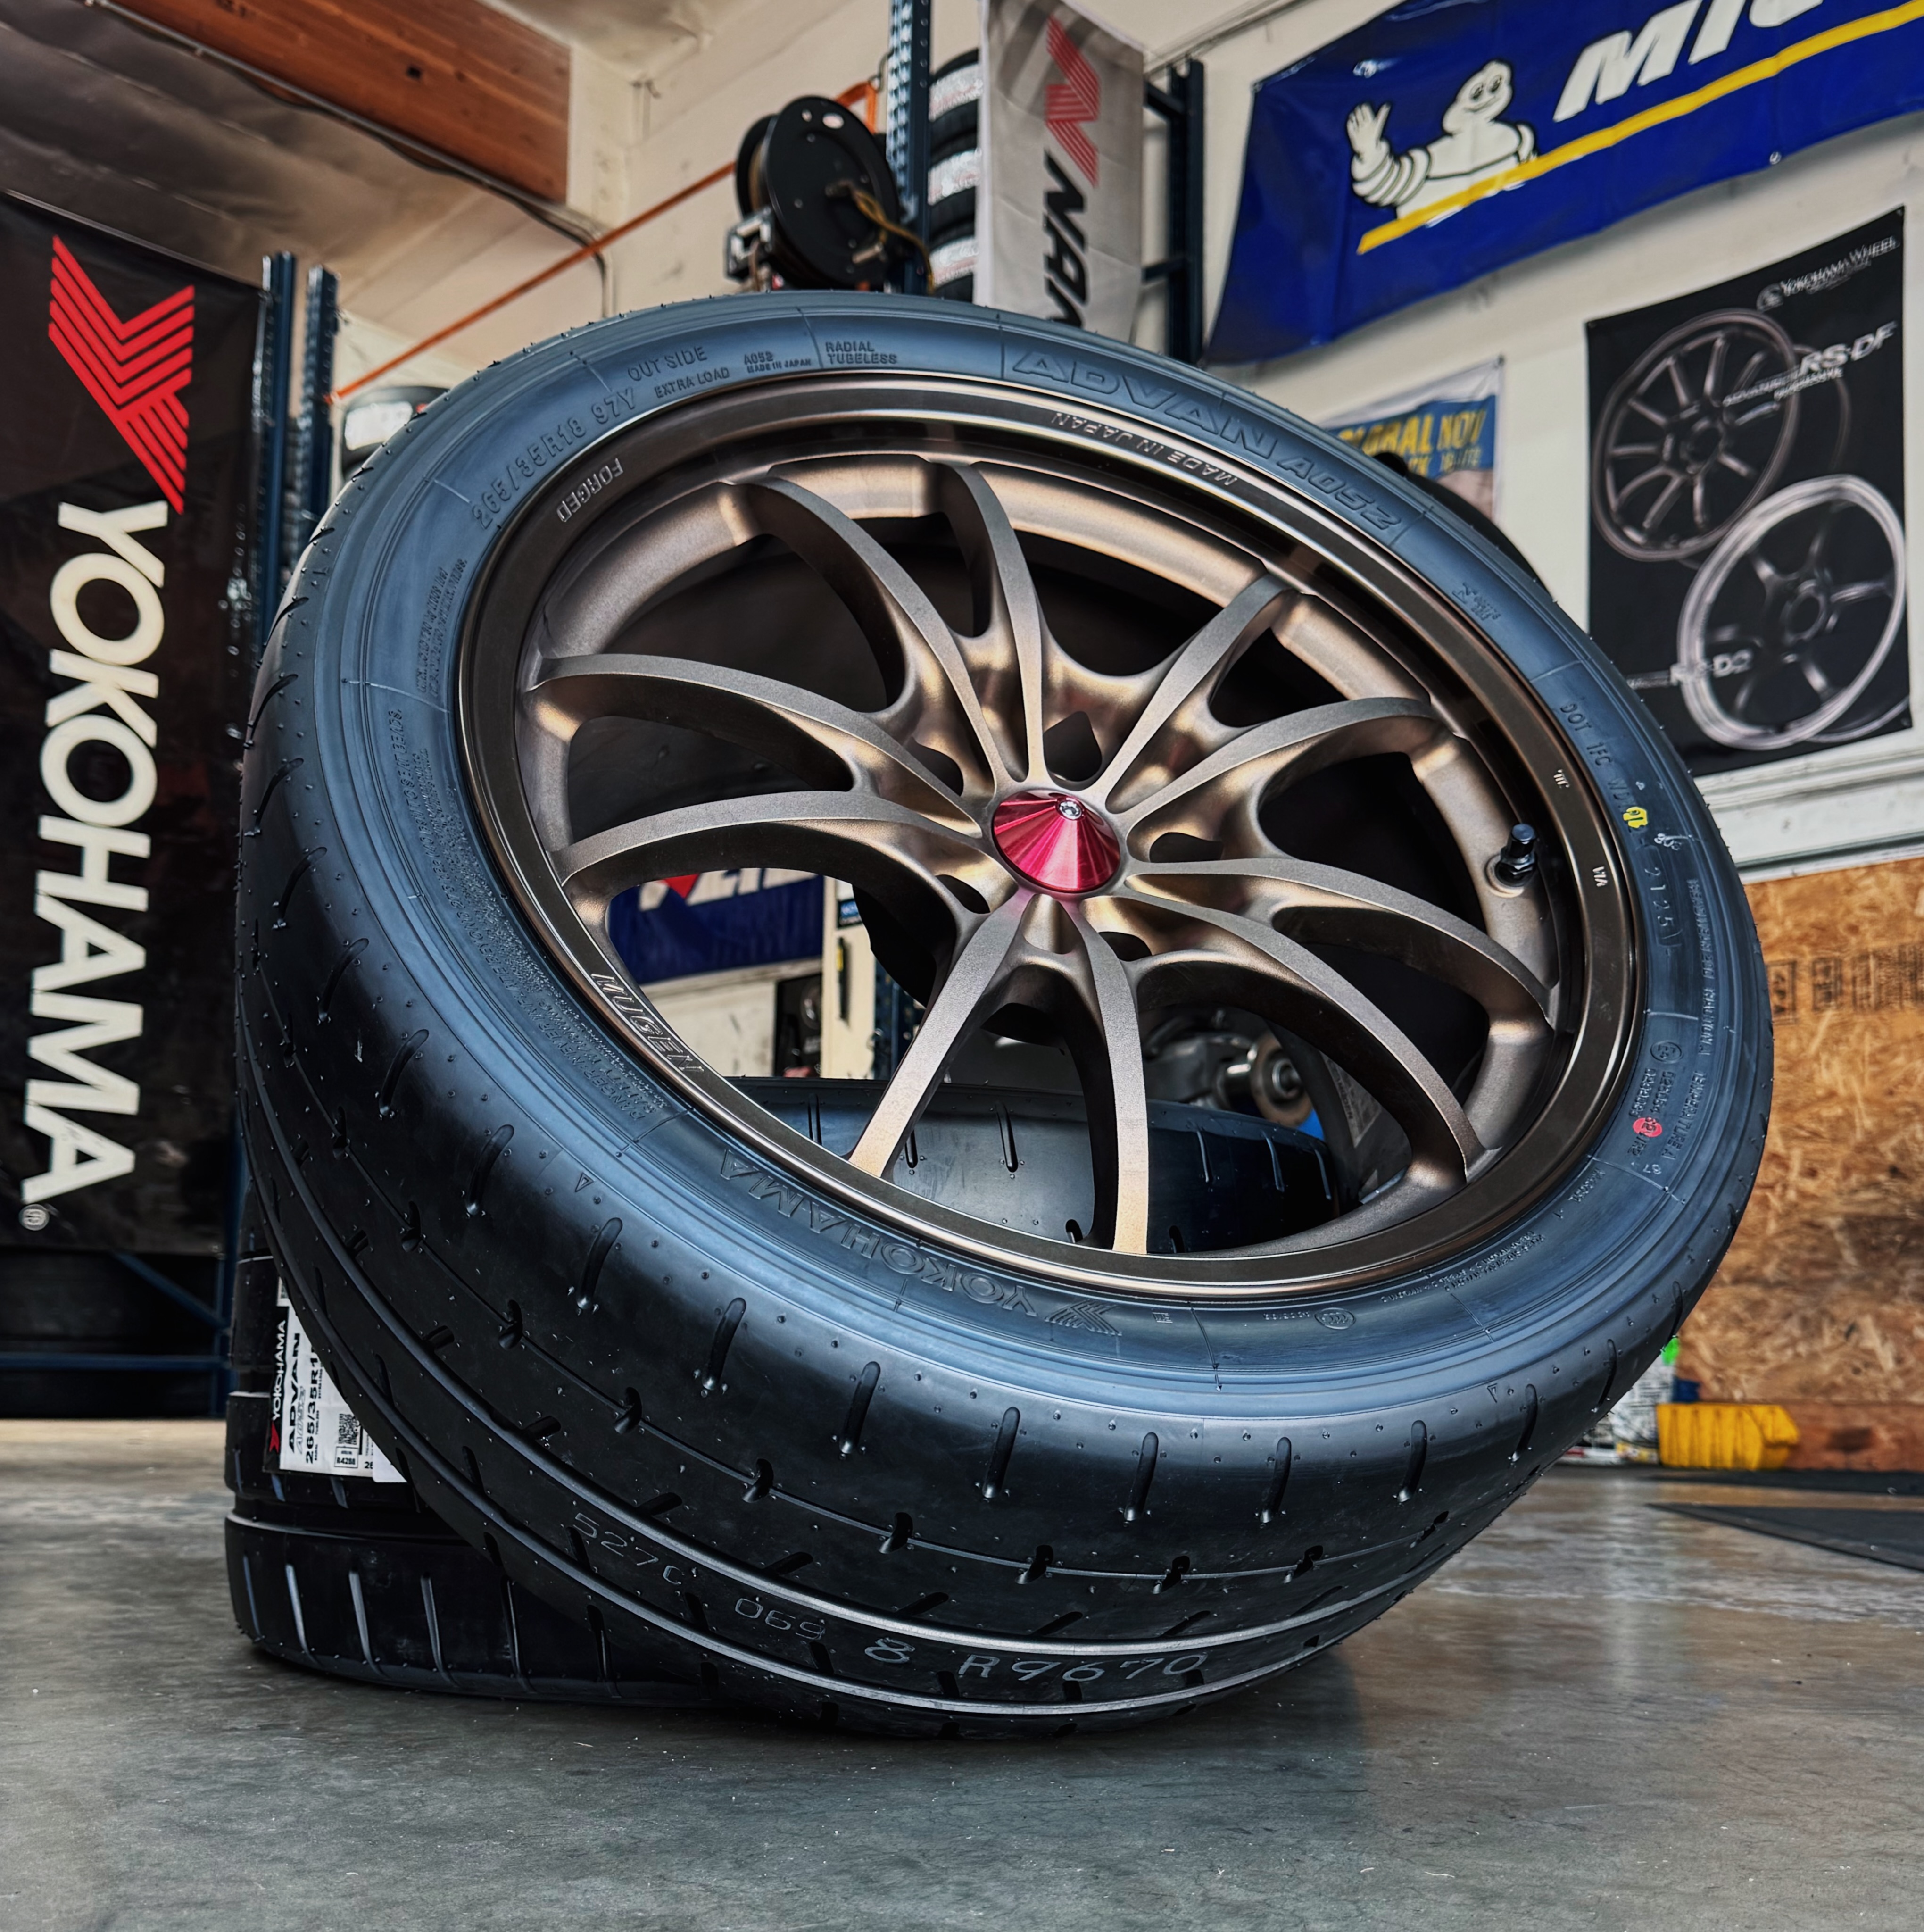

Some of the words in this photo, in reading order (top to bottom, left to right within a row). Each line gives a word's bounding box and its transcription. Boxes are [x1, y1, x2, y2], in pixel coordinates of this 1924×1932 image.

[655, 375, 694, 398] EXTRA
[697, 367, 729, 388] LOAD
[784, 357, 812, 369] JAPAN
[825, 341, 874, 353] RADIAL
[827, 352, 897, 366] TUBELESS
[472, 416, 587, 529] 265/35R18
[591, 388, 637, 425] 97Y
[1012, 350, 1278, 459] ADVAN
[1277, 455, 1401, 531] A052
[1052, 412, 1132, 450] JAPAN
[1137, 439, 1161, 458] IN
[1167, 450, 1237, 487] MADE
[557, 457, 624, 523] FORGED
[1560, 703, 1592, 732] DOT
[21, 500, 169, 1204] YOKOHAMA
[591, 974, 704, 1072] MUGEN
[720, 1148, 1037, 1316] YOKOHAMA
[273, 1320, 286, 1421] YOKOHAMA
[288, 1333, 300, 1453] ADVAN
[306, 1347, 318, 1464] 265/35R1
[735, 1598, 827, 1639] 069
[864, 1636, 916, 1664] 8
[957, 1653, 1209, 1684] R9670
